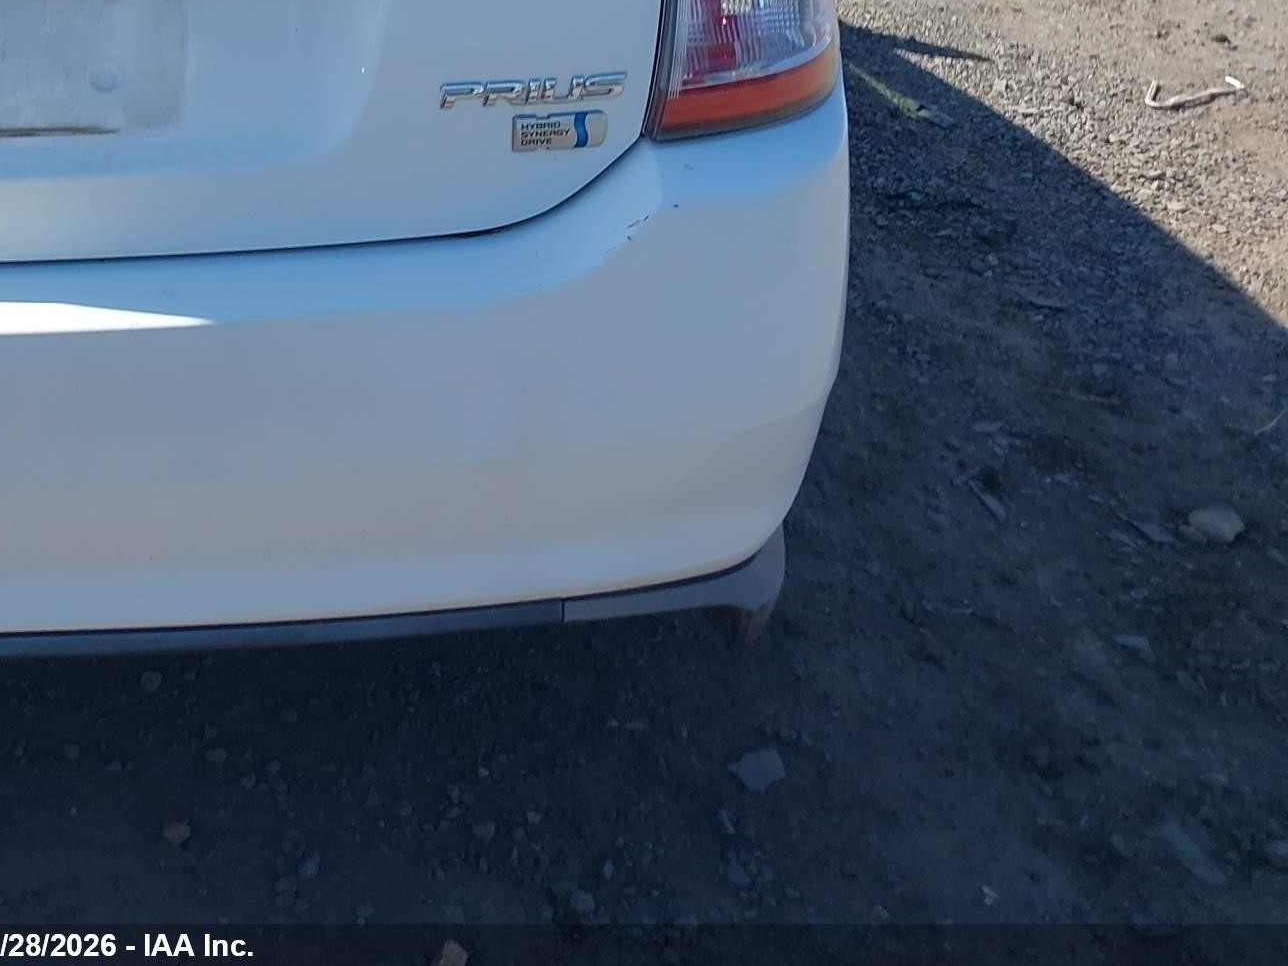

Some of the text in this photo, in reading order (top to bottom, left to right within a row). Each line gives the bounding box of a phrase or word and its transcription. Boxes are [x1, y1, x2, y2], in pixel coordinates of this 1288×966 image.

[439, 70, 628, 109] PRIUS
[520, 120, 561, 130] HYBRID
[520, 128, 571, 138] SYNERGY
[520, 137, 553, 146] DRIVE
